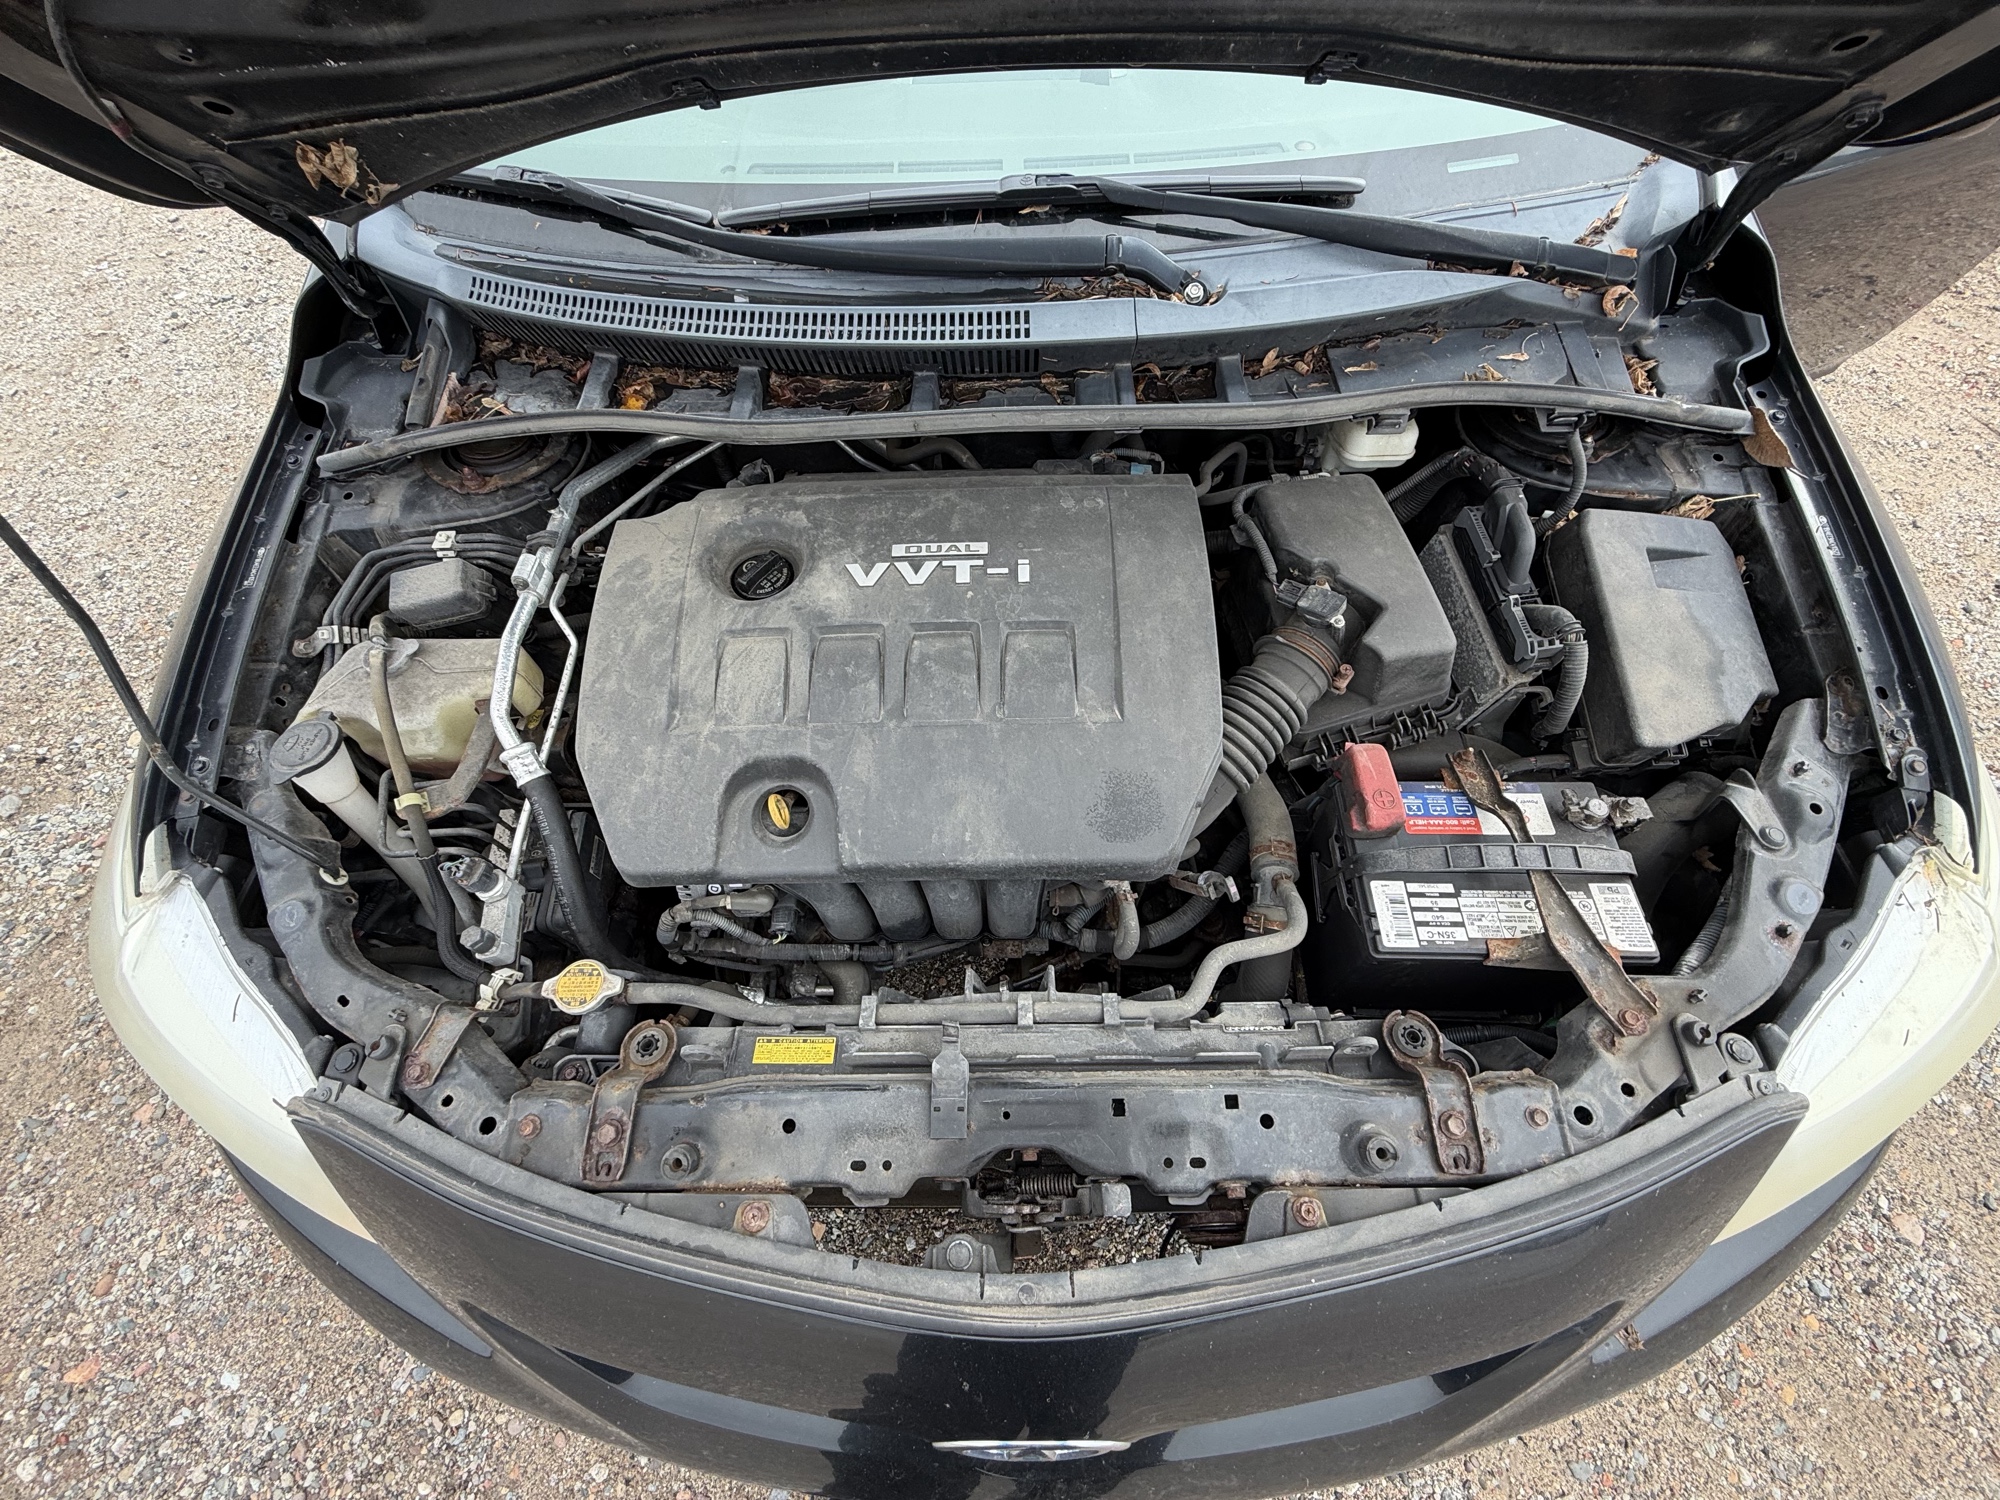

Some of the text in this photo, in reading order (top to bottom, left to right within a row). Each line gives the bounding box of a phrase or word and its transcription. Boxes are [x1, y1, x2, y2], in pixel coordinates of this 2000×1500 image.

[904, 544, 980, 554] DUAL
[844, 558, 1030, 587] VVT-i
[1426, 931, 1456, 939] 35N-C
